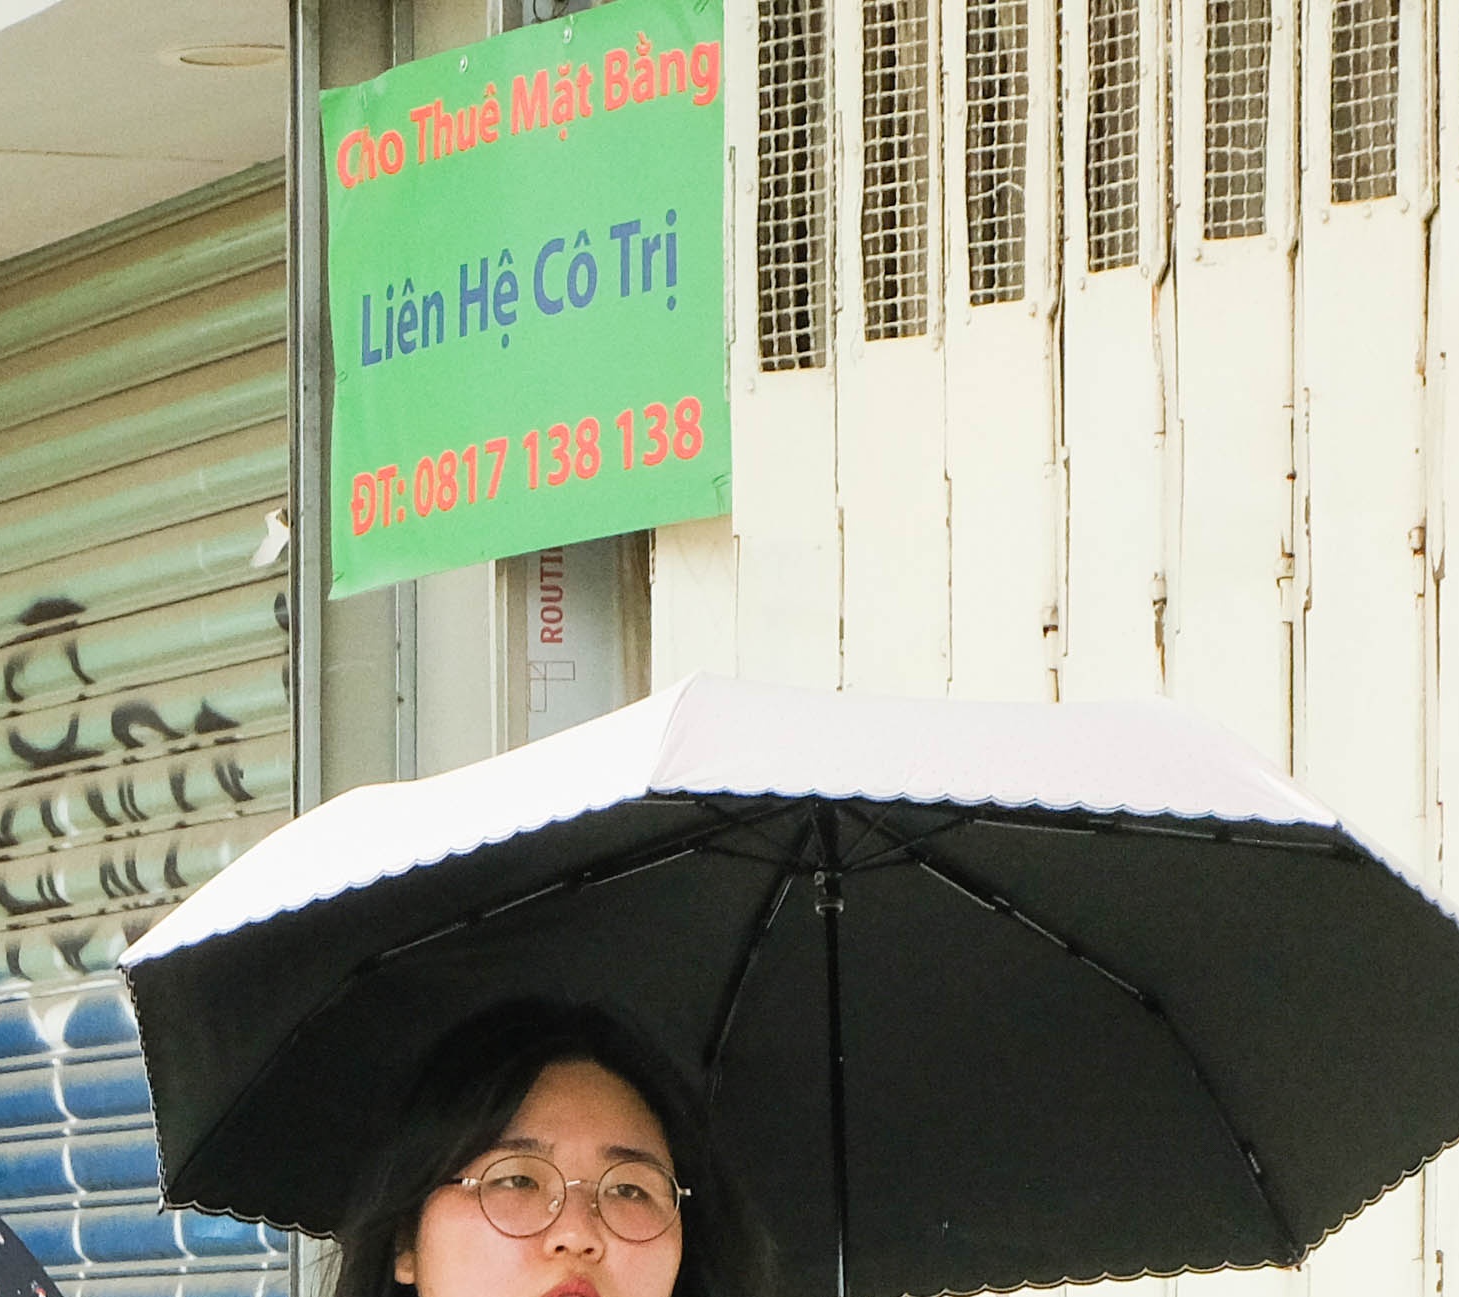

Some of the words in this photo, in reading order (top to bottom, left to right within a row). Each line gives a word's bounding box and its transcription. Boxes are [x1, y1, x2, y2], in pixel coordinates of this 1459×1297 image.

[336, 126, 405, 190] Cho
[409, 81, 501, 165] Thuê
[510, 62, 594, 141] Mặt
[604, 31, 721, 112] Bằng
[361, 277, 444, 367] Liên
[458, 248, 519, 349] Hệ
[533, 228, 598, 316] Cô
[609, 208, 677, 311] Trị
[350, 464, 405, 537] ĐT:
[413, 436, 510, 517] 0817
[522, 416, 603, 490] 138
[615, 395, 705, 471] 138
[540, 546, 565, 643] ROUTI
